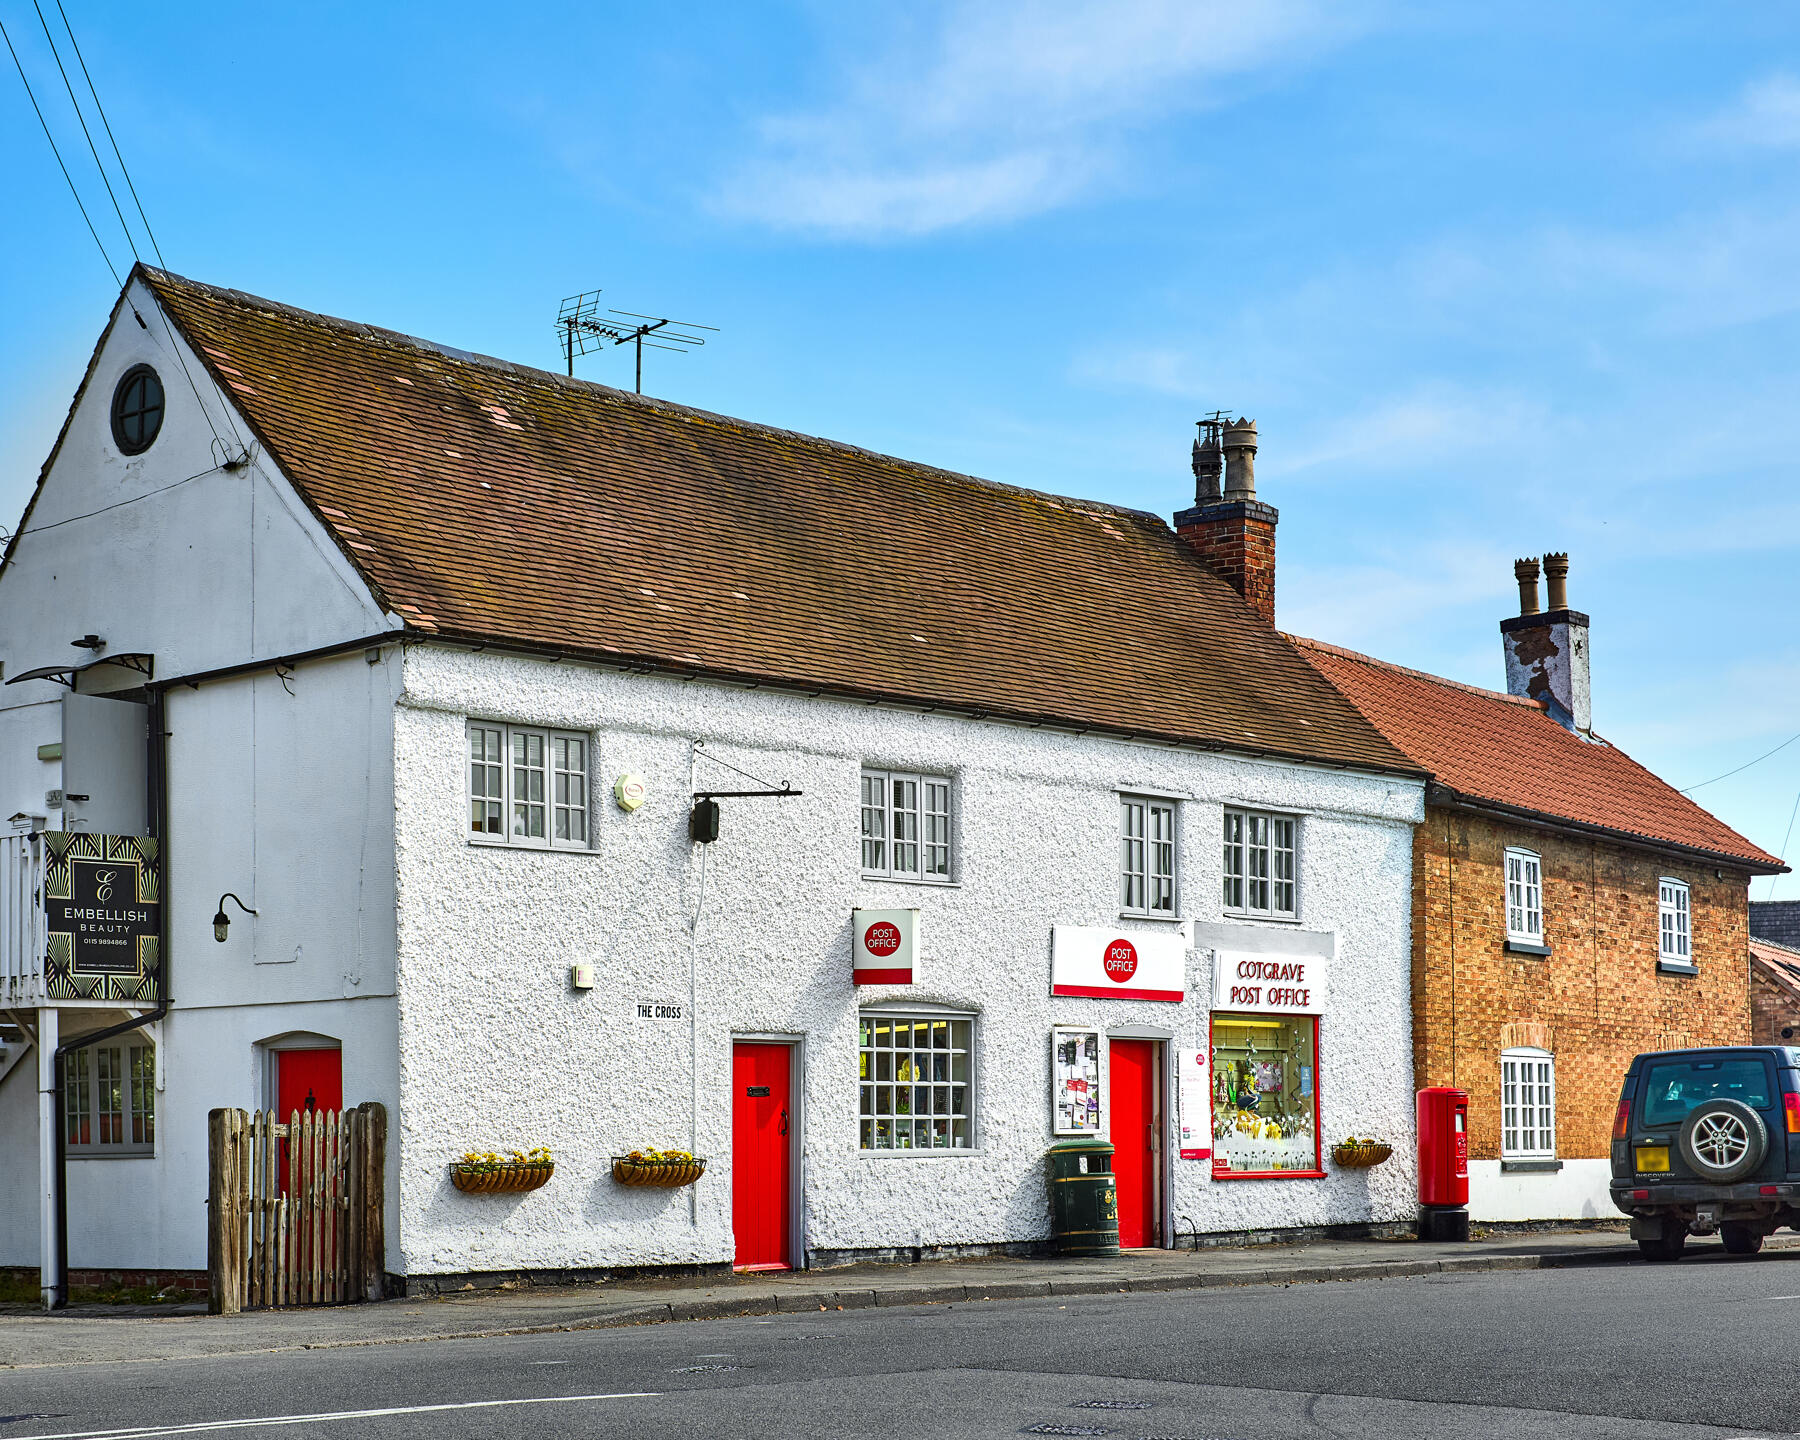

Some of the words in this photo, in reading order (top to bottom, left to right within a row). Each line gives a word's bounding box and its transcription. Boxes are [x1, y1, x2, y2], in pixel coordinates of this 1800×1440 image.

[95, 869, 117, 904] E
[64, 907, 147, 922] EMBELLISH
[80, 923, 131, 933] BEAUTY
[872, 928, 894, 938] POST
[867, 938, 897, 948] OFFICE
[1111, 947, 1132, 960] POST
[1106, 959, 1134, 972] OFFICE
[1237, 960, 1305, 982] COTGRAVE
[1231, 986, 1262, 1004] POST
[1268, 987, 1310, 1006] OFFICE
[637, 1004, 653, 1018] THE
[655, 1005, 681, 1019] CROSS
